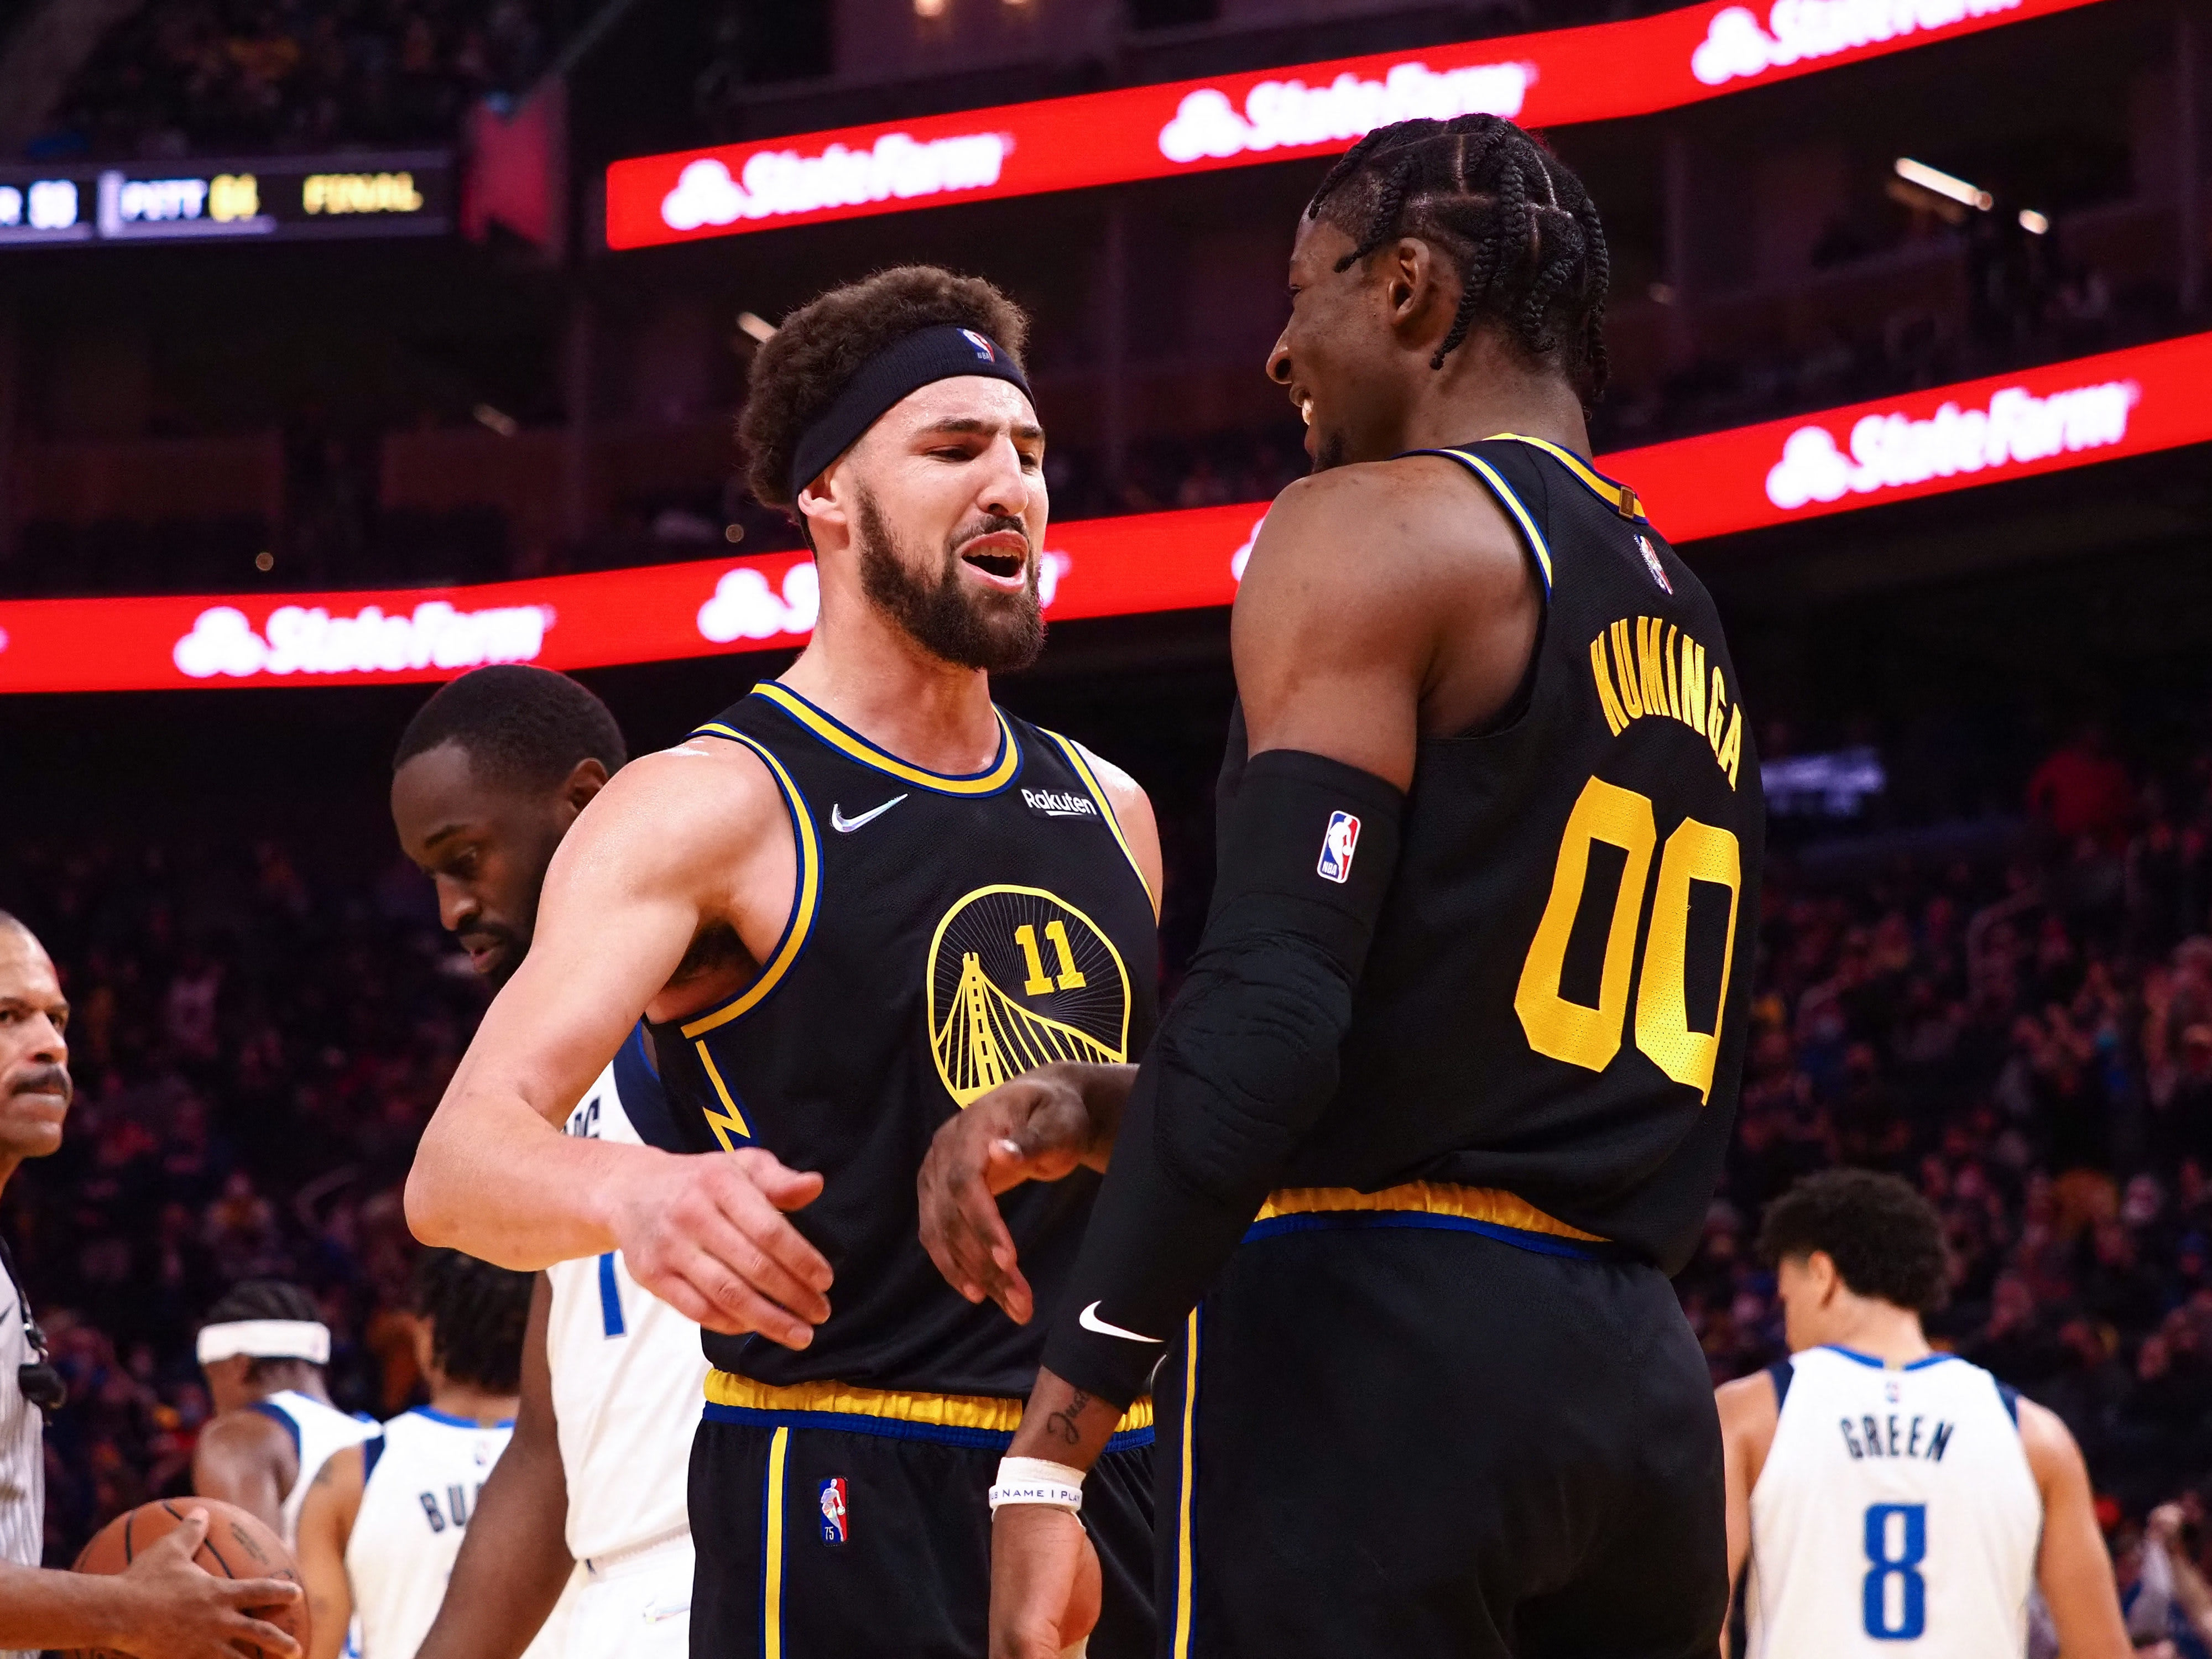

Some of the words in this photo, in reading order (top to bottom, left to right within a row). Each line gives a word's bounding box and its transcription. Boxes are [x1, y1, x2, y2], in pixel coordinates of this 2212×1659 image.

[1590, 615, 1742, 792] KUMINGA
[1021, 789, 1097, 816] Rakuten
[1322, 860, 1338, 876] NBA
[1014, 920, 1087, 996] 11
[1514, 775, 1741, 1106] 00
[1839, 1413, 1955, 1463] GREEN
[825, 1526, 834, 1540] 75
[1862, 1502, 1927, 1642] 8
